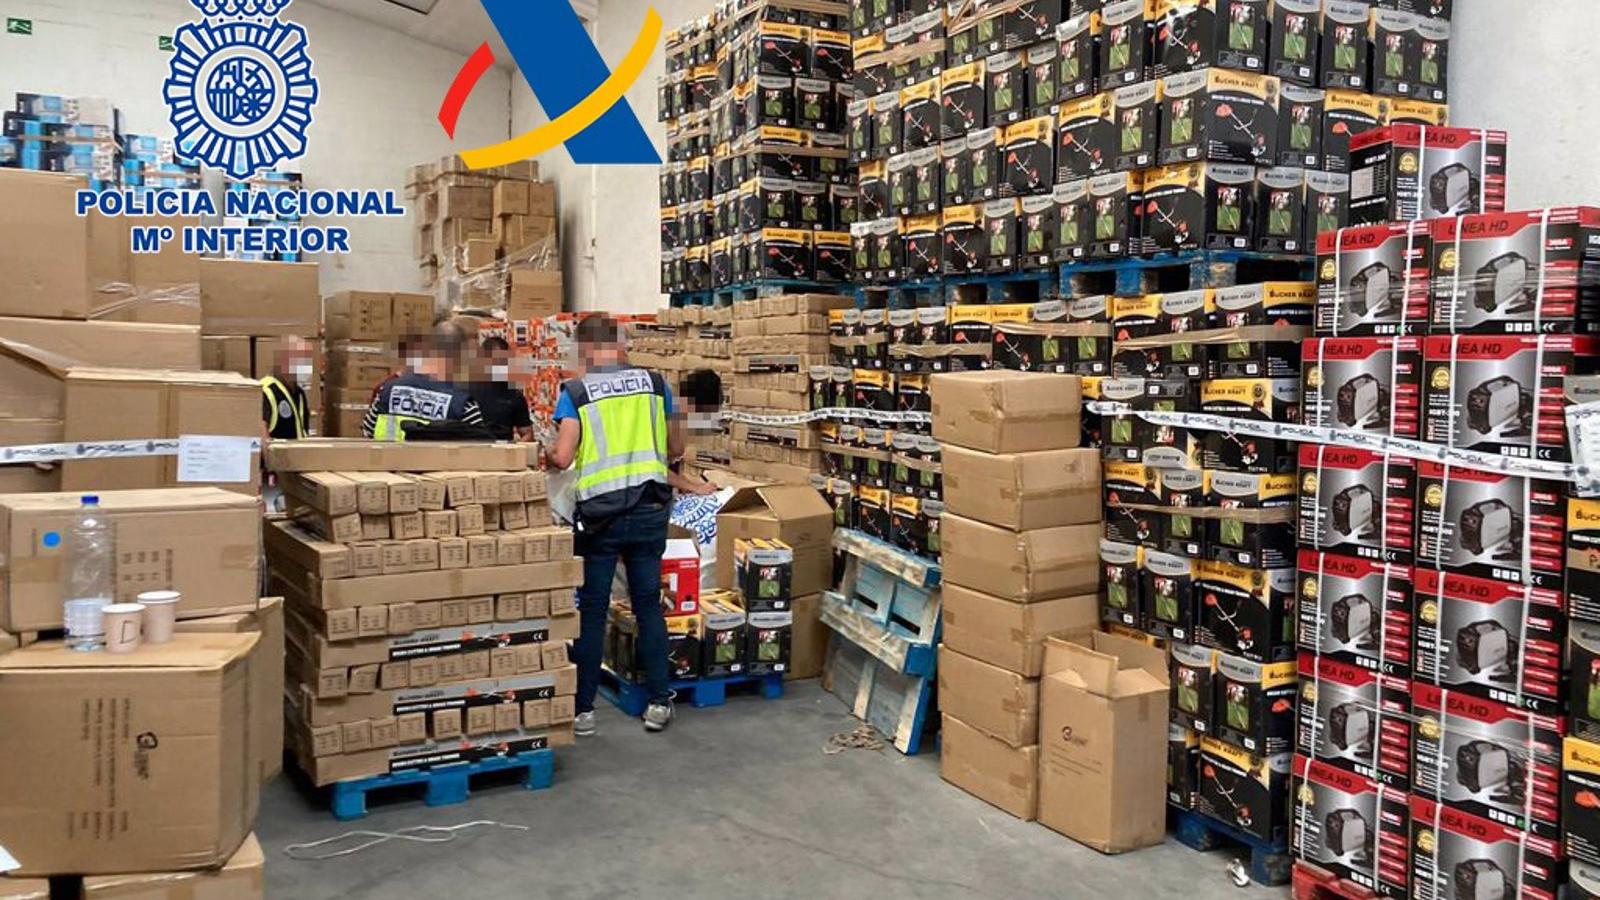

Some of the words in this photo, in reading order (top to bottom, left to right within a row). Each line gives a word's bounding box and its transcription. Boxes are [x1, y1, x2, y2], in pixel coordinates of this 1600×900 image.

[1408, 131, 1438, 142] LIEA
[1441, 132, 1457, 143] HD
[1448, 222, 1486, 234] LNEA
[1489, 220, 1509, 232] HD
[1327, 235, 1357, 247] LNEA
[1360, 234, 1375, 244] HD
[1298, 290, 1314, 298] KRAF
[1314, 344, 1344, 355] LNEA
[1347, 344, 1363, 354] HD
[1440, 343, 1478, 354] LNEA
[1482, 343, 1502, 354] HD
[588, 377, 651, 398] POLICIA
[391, 396, 445, 419] POLICIA
[1309, 451, 1339, 463] LIEA
[1342, 453, 1357, 464] HD
[1342, 561, 1357, 574] HD
[1470, 584, 1490, 597] HD
[1339, 668, 1355, 681] HD
[1427, 692, 1464, 711] LIEA
[1469, 703, 1488, 717] HD
[1335, 775, 1352, 788] HD
[1425, 807, 1464, 829] LNEA
[1467, 821, 1487, 836] HD
